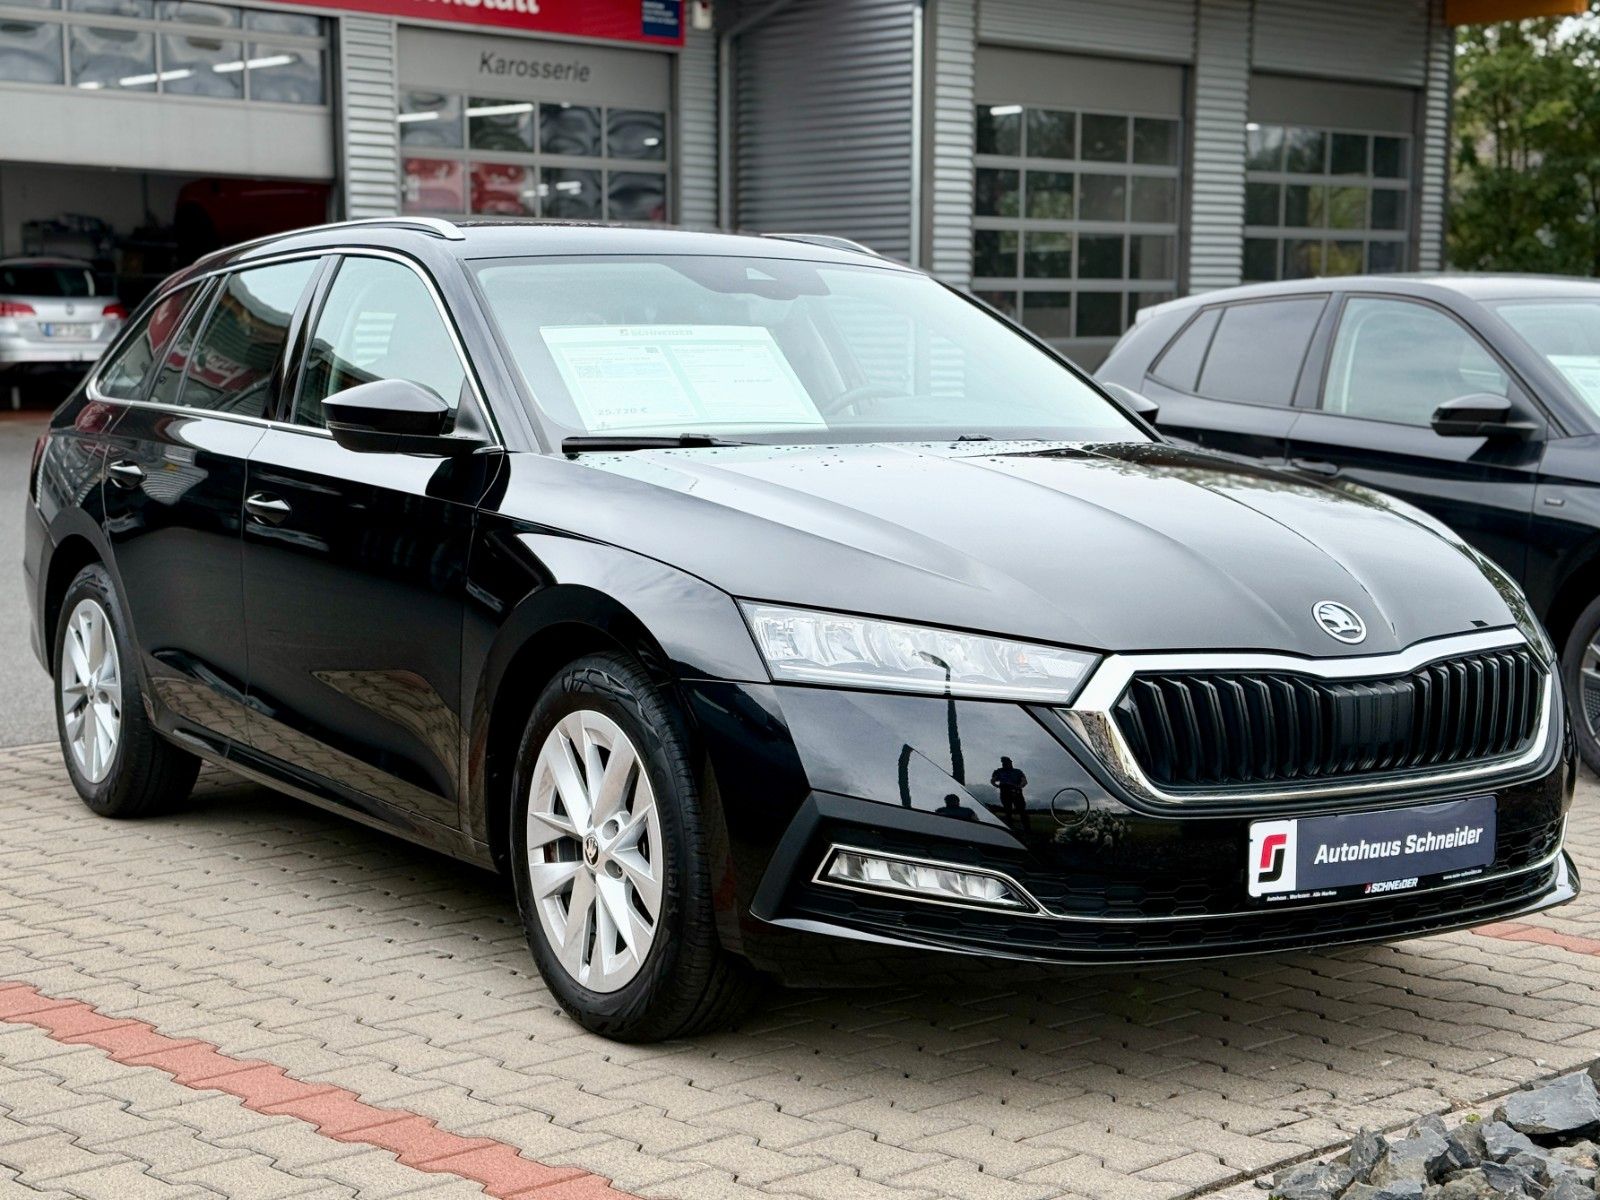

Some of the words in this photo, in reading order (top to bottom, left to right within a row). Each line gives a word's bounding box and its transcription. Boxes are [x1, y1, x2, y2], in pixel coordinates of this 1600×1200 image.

[478, 51, 591, 82] Karosserie
[1313, 839, 1401, 865] Autohaus
[1404, 825, 1484, 855] Schneider
